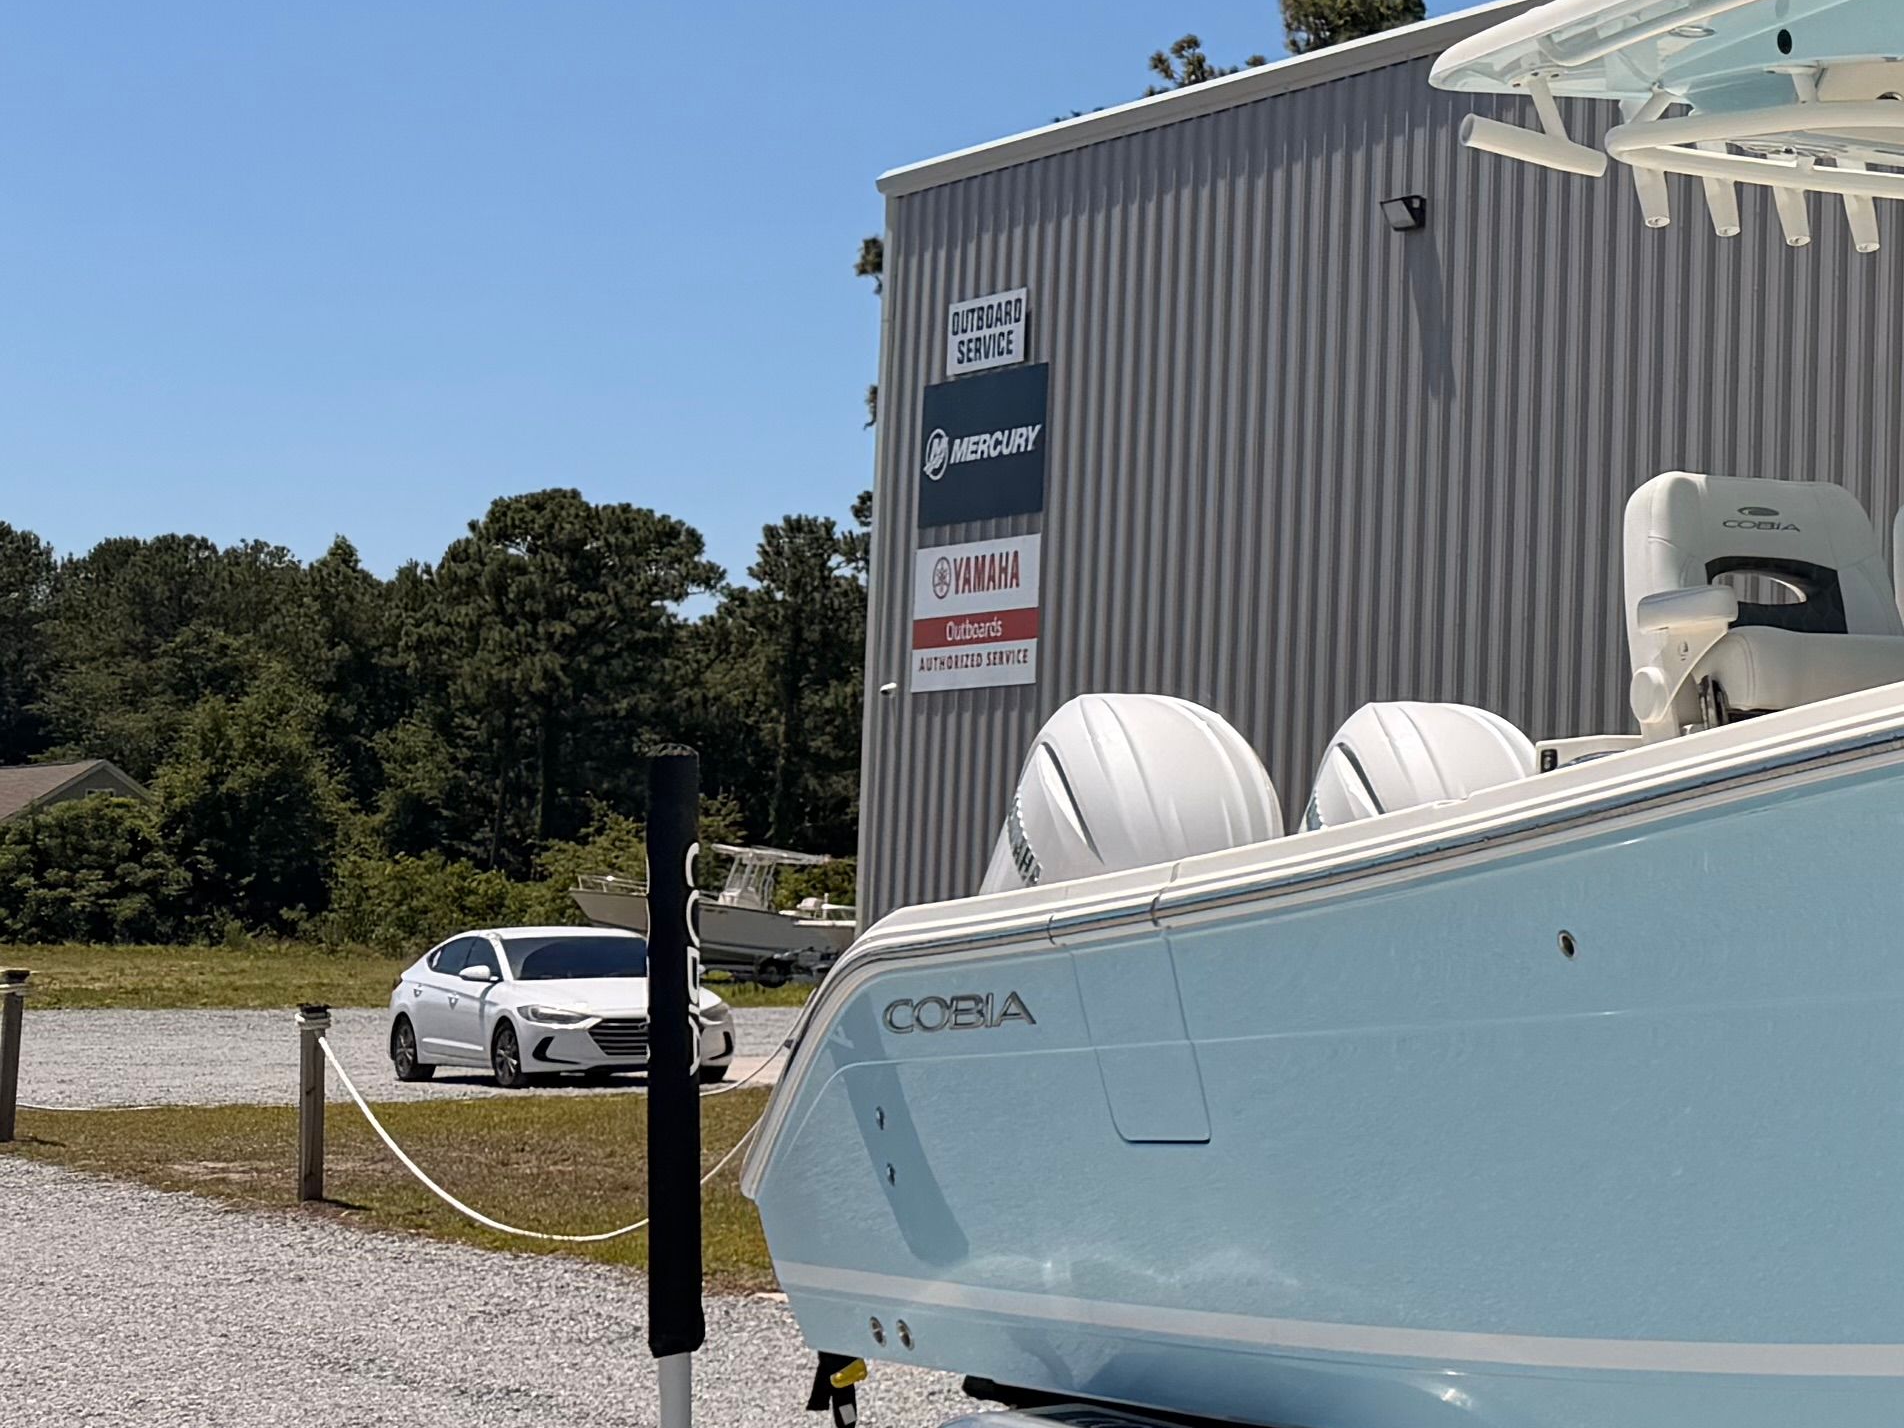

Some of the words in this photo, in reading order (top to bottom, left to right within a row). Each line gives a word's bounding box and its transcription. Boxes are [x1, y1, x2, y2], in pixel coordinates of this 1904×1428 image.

[952, 297, 1023, 337] OUTBOARD
[957, 329, 1014, 365] SERVICE
[949, 424, 1042, 465] MERCURY
[1722, 519, 1801, 532] COBIA
[953, 550, 1020, 595] YAMAHA
[946, 616, 1003, 642] Outboards
[919, 651, 983, 673] AUTHORIZED
[985, 648, 1029, 667] SERVICE
[882, 990, 1037, 1035] COBIA
